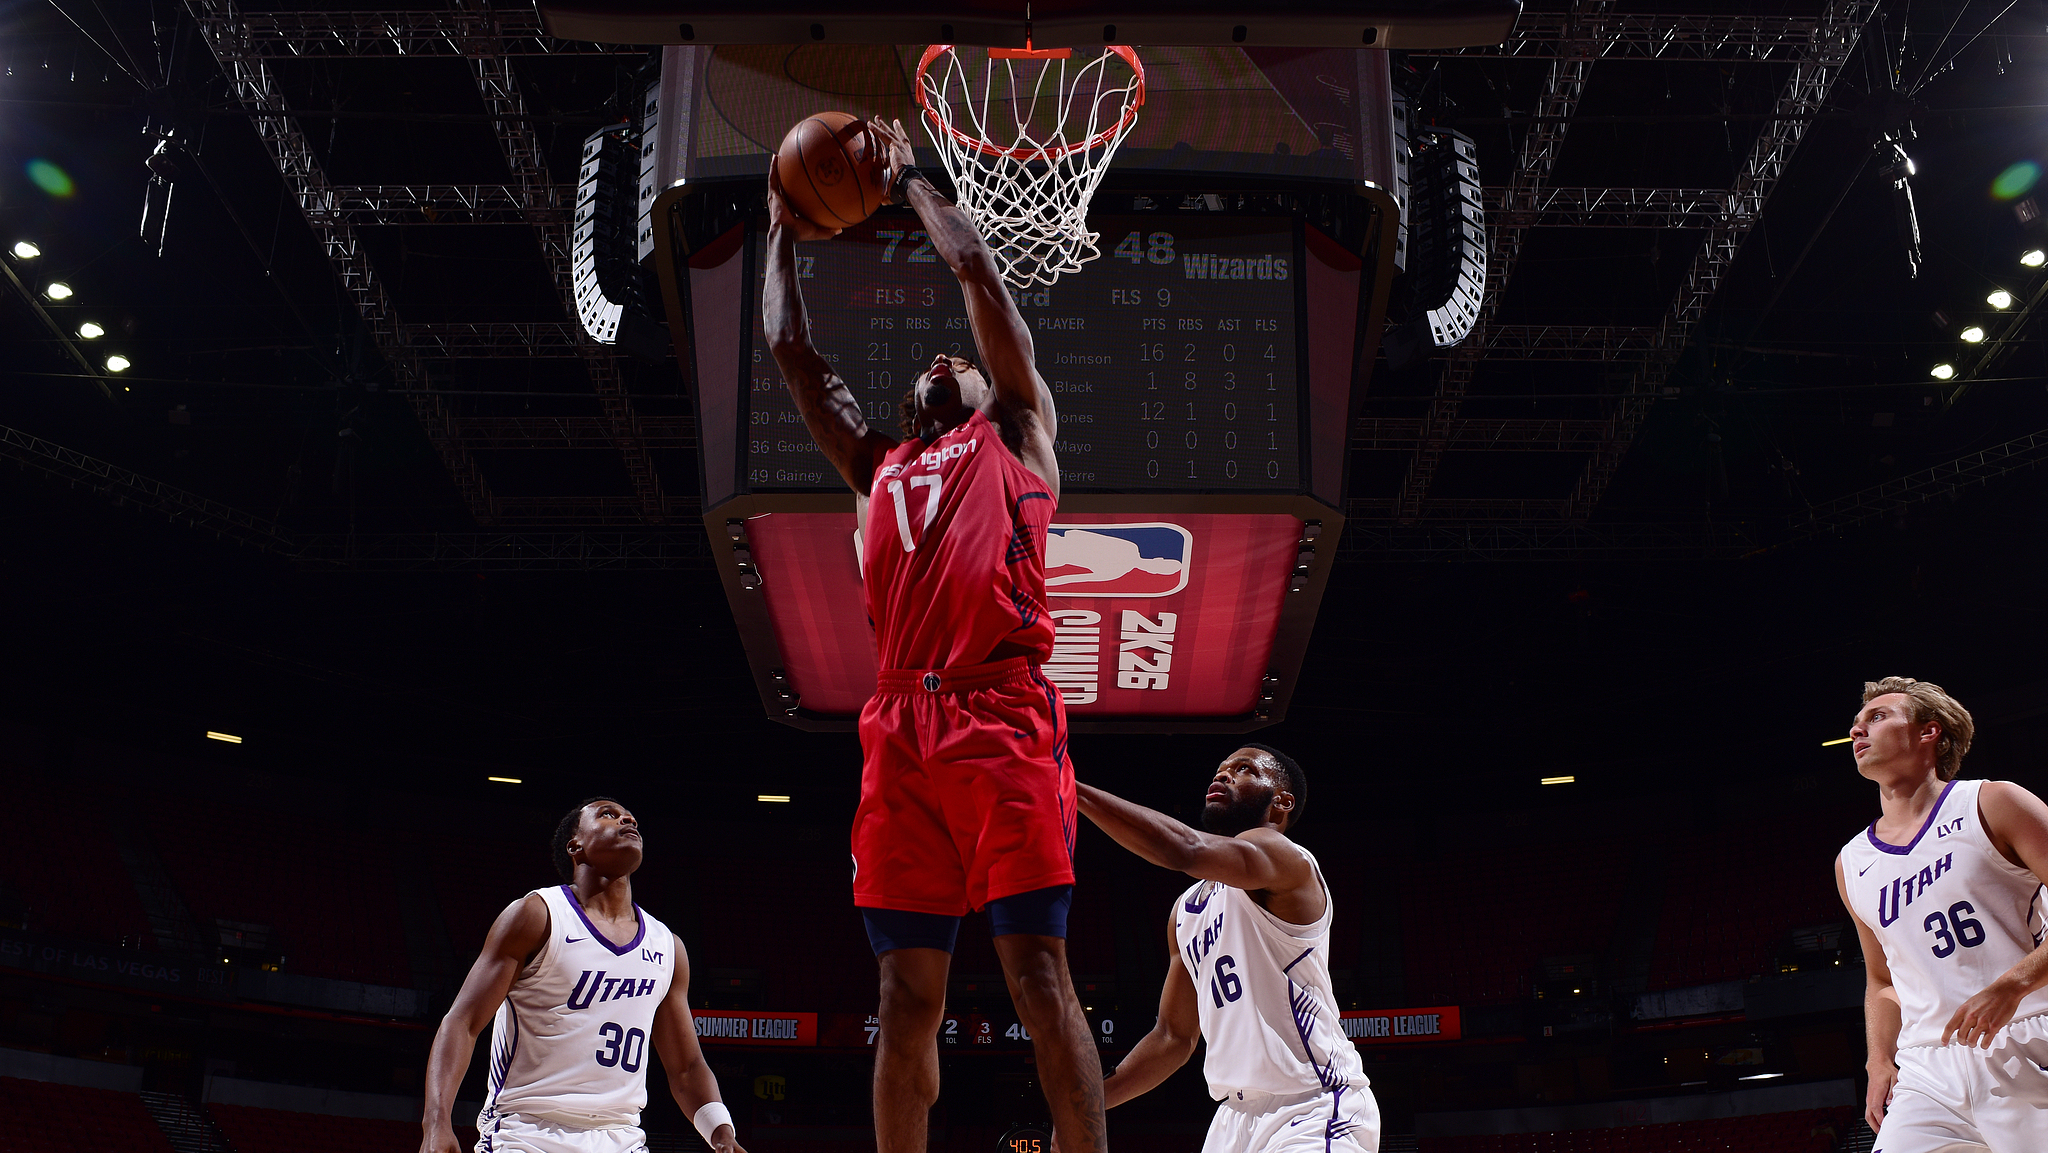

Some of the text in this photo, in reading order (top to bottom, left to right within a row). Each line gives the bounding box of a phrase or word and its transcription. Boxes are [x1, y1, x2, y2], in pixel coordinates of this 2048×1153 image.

[876, 230, 936, 262] 72
[1114, 231, 1176, 265] 48
[1183, 254, 1289, 281] Wizards
[876, 287, 935, 306] FLS 3
[1112, 288, 1171, 307] FLS 9
[870, 318, 969, 330] PTS RBS AST
[1038, 318, 1277, 331] PLAYER PTS RBS AST FLS
[754, 350, 762, 362] 5
[868, 343, 891, 360] 21
[911, 343, 923, 360] 0
[1054, 343, 1276, 364] Johnson 16 2 0 4
[752, 378, 771, 391] 16
[868, 371, 892, 389] 10
[1055, 372, 1276, 393] Black 1 8 3 1
[751, 412, 804, 424] 30 Abn
[867, 402, 890, 419] 10
[1141, 402, 1164, 420] 12
[1186, 402, 1197, 420] 1
[1224, 403, 1236, 421] 0
[1267, 403, 1277, 421] 1
[750, 440, 770, 454] 36
[1055, 431, 1277, 454] Mayo 0 0 0 1
[750, 469, 823, 483] 49 Gainey
[1147, 460, 1159, 478] 0
[1187, 460, 1197, 478] 1
[1226, 460, 1237, 478] 0
[1267, 460, 1279, 479] 0
[887, 474, 942, 552] 17
[1117, 610, 1177, 690] 2K26
[1936, 817, 1964, 838] LVT
[1878, 852, 1953, 928] UTAH
[1924, 900, 1986, 958] 36
[1186, 912, 1223, 980] UAH
[0, 938, 181, 982] EST OF LAS VEGAS
[642, 948, 663, 965] LVT
[567, 970, 656, 1010] UTAH
[1211, 955, 1242, 1008] 16
[694, 1016, 798, 1039] SUMMER LEAGUE
[864, 1015, 879, 1024] Ja
[945, 1019, 958, 1034] 2
[980, 1022, 990, 1034] 3
[1101, 1019, 1114, 1035] 0
[1394, 1014, 1440, 1036] LEAGUE
[864, 1027, 880, 1044] 7
[978, 1036, 992, 1044] FLS
[596, 1022, 645, 1073] 30
[1616, 1104, 1648, 1122] 102
[1009, 1139, 1041, 1153] 40.5
